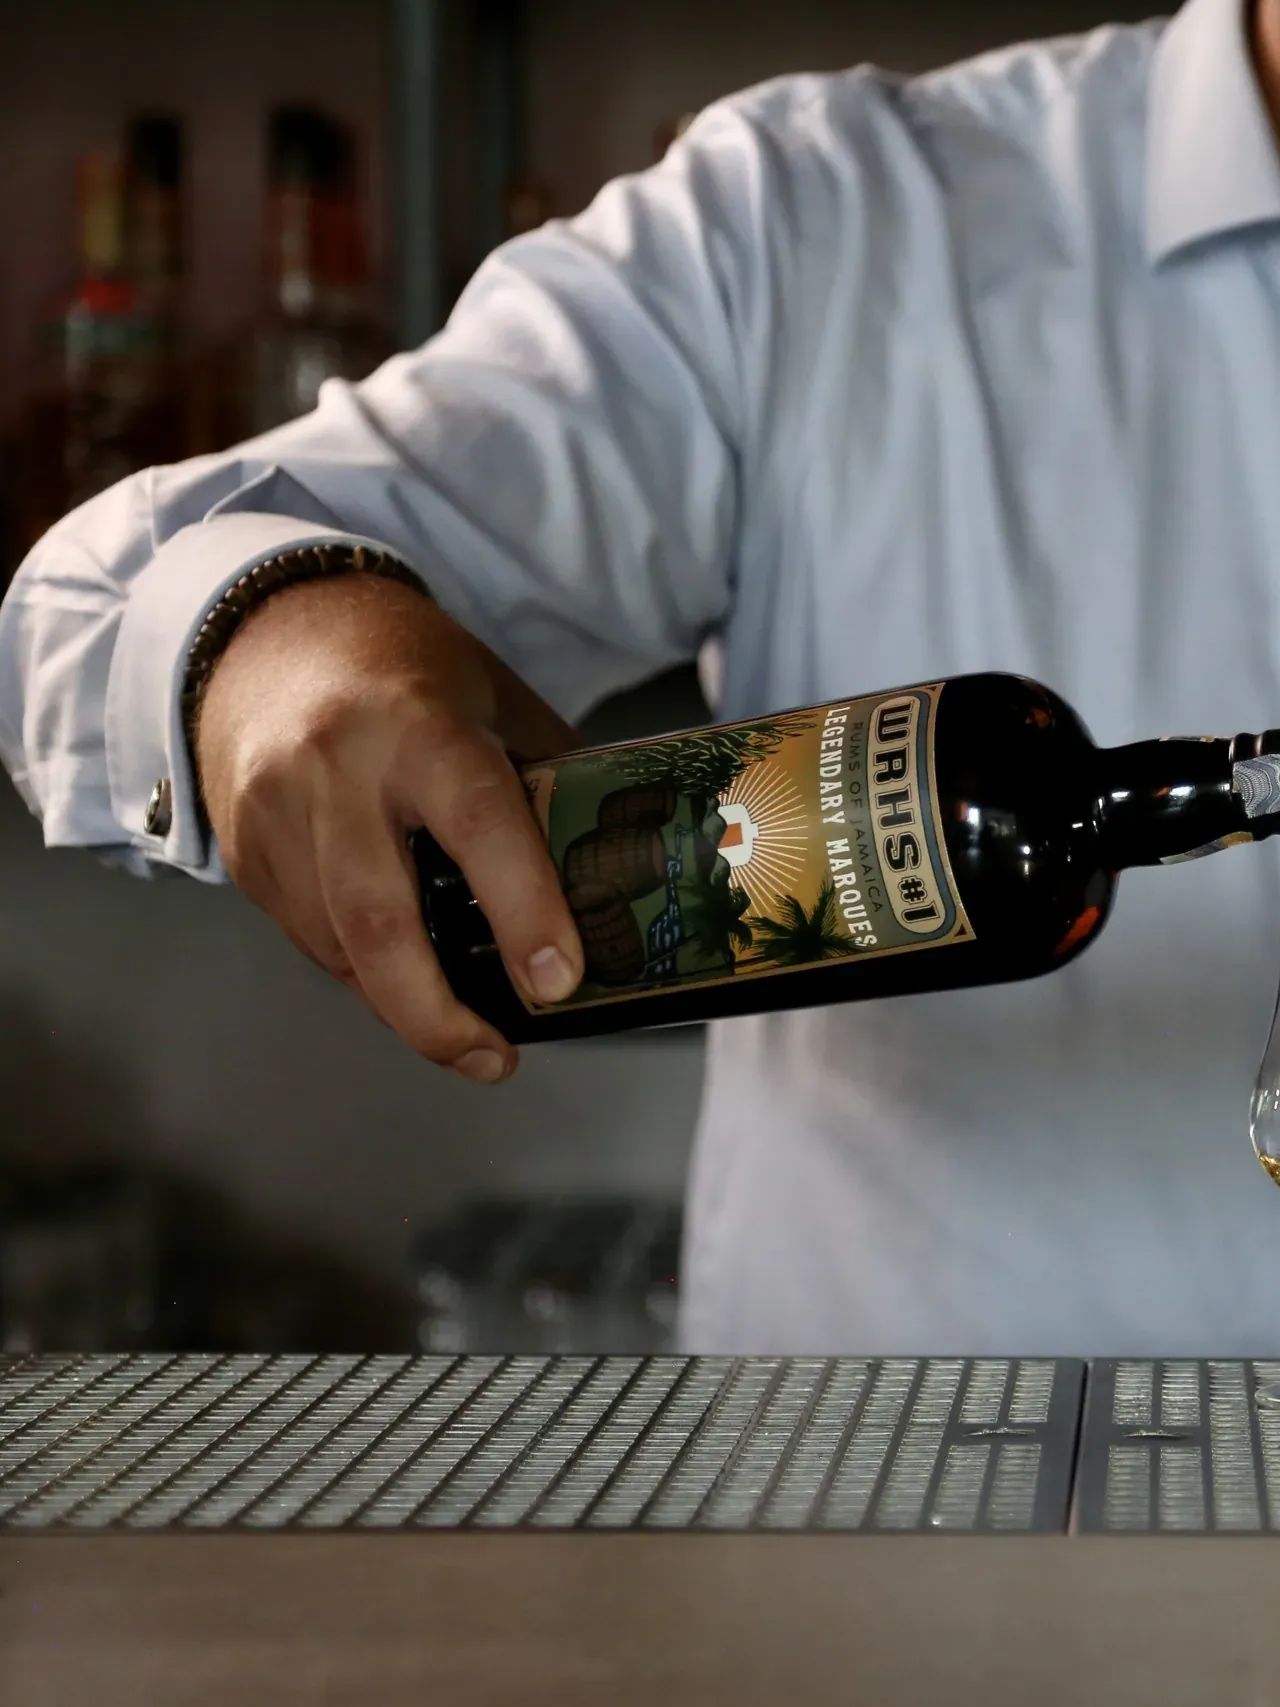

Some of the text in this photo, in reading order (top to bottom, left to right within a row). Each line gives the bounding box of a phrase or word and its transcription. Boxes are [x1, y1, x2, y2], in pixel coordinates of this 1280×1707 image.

[819, 706, 878, 947] LEGENDARY MARQUES
[848, 721, 884, 913] RUMS OF JAMAICA
